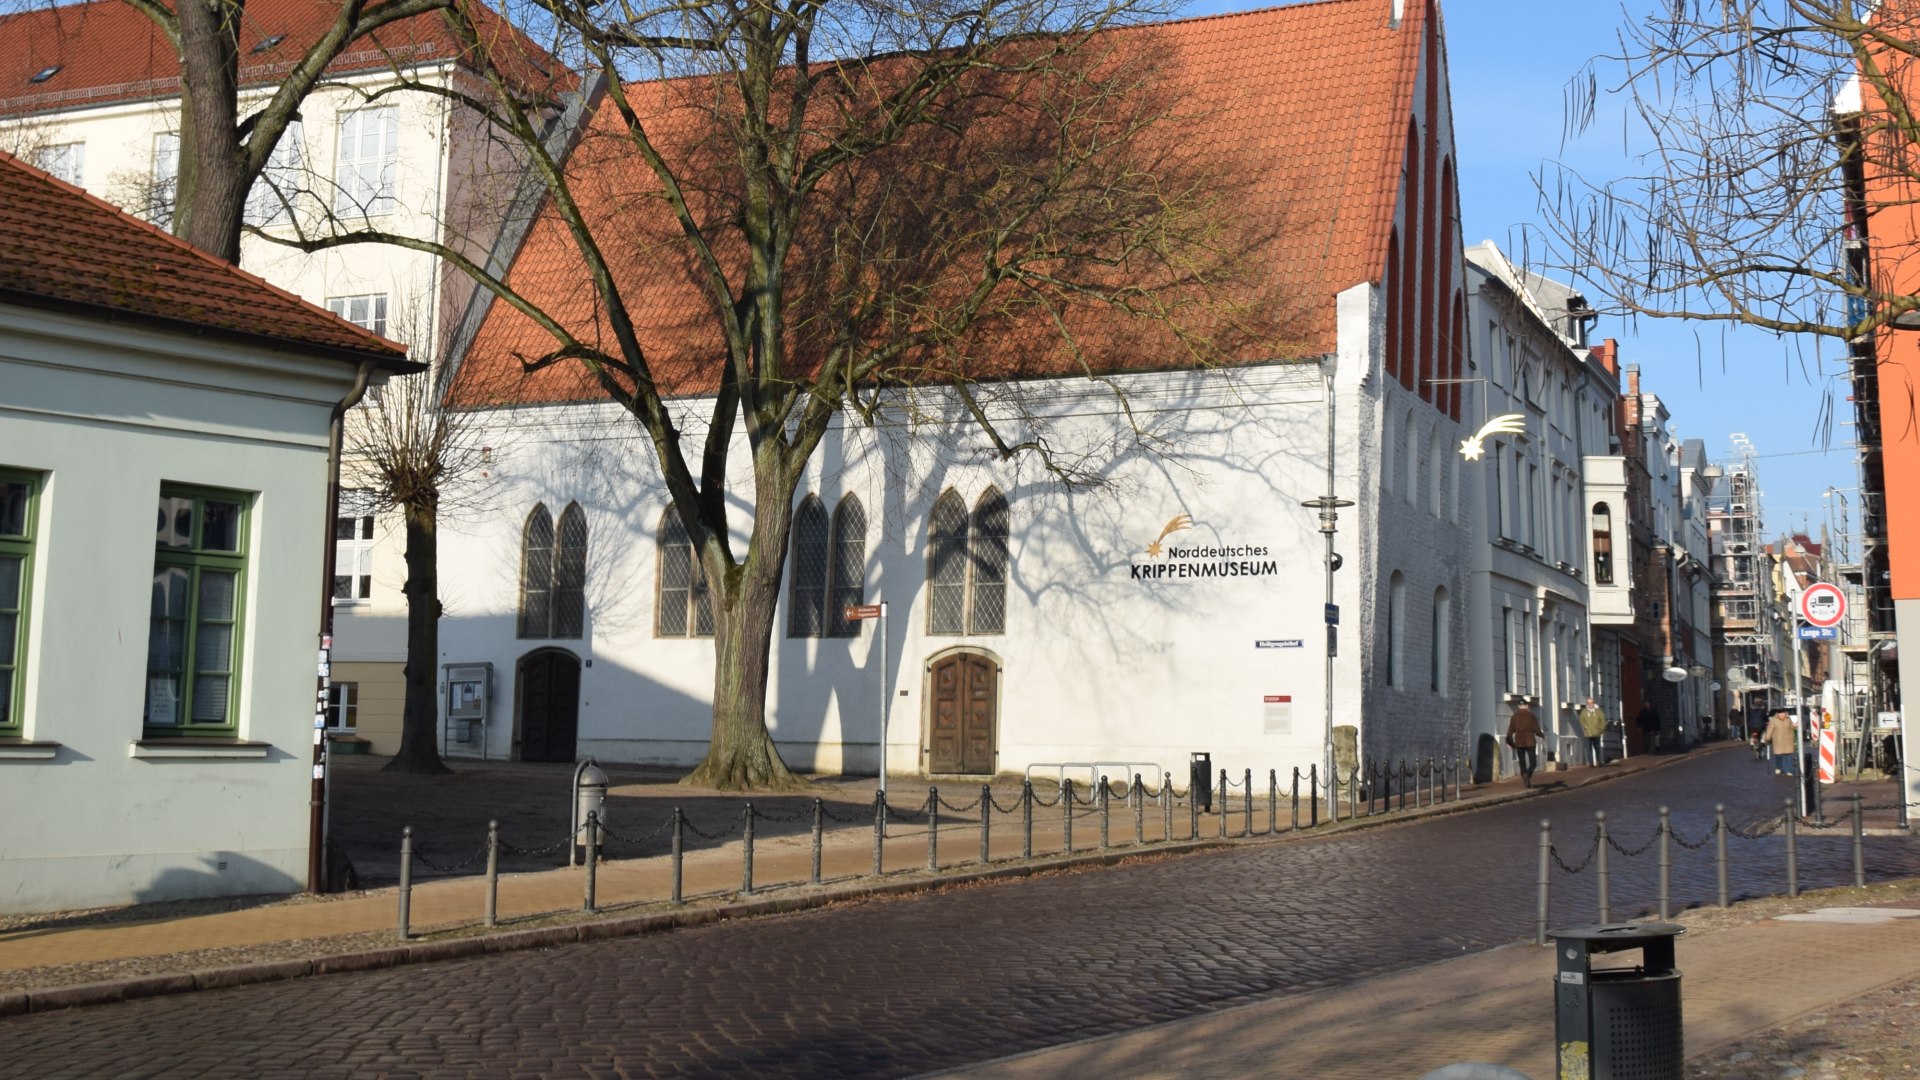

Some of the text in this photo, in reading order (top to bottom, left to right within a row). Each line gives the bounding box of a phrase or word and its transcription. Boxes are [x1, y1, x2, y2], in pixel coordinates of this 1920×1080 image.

[1168, 544, 1268, 559] Norddeutsches
[1130, 560, 1278, 580] KRIPPENMUSEUM
[1800, 628, 1833, 638] Lange Str.
